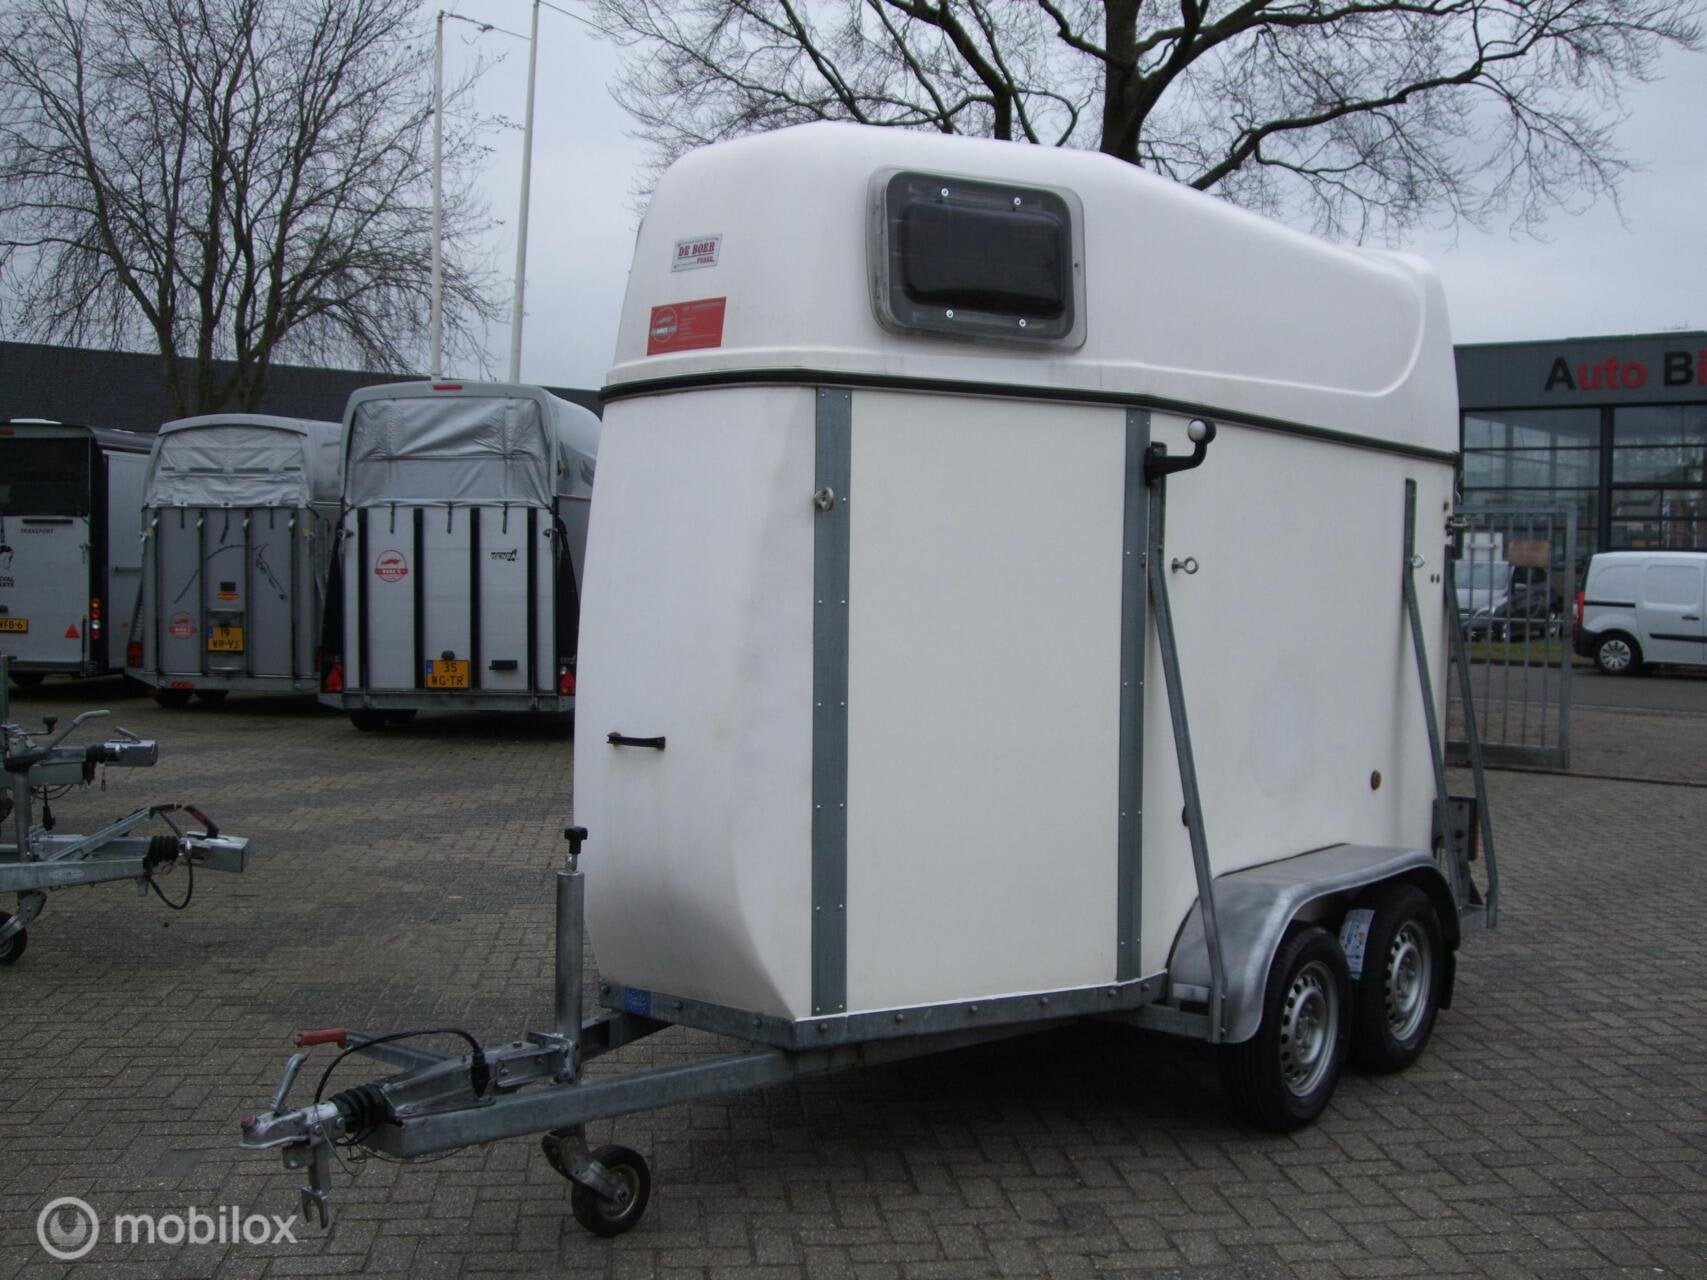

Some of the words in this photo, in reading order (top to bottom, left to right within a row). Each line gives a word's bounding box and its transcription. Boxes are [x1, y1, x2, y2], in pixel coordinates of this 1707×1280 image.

[1544, 355, 1649, 392] Auto
[443, 662, 458, 673] 35
[431, 674, 465, 686] WG-TR
